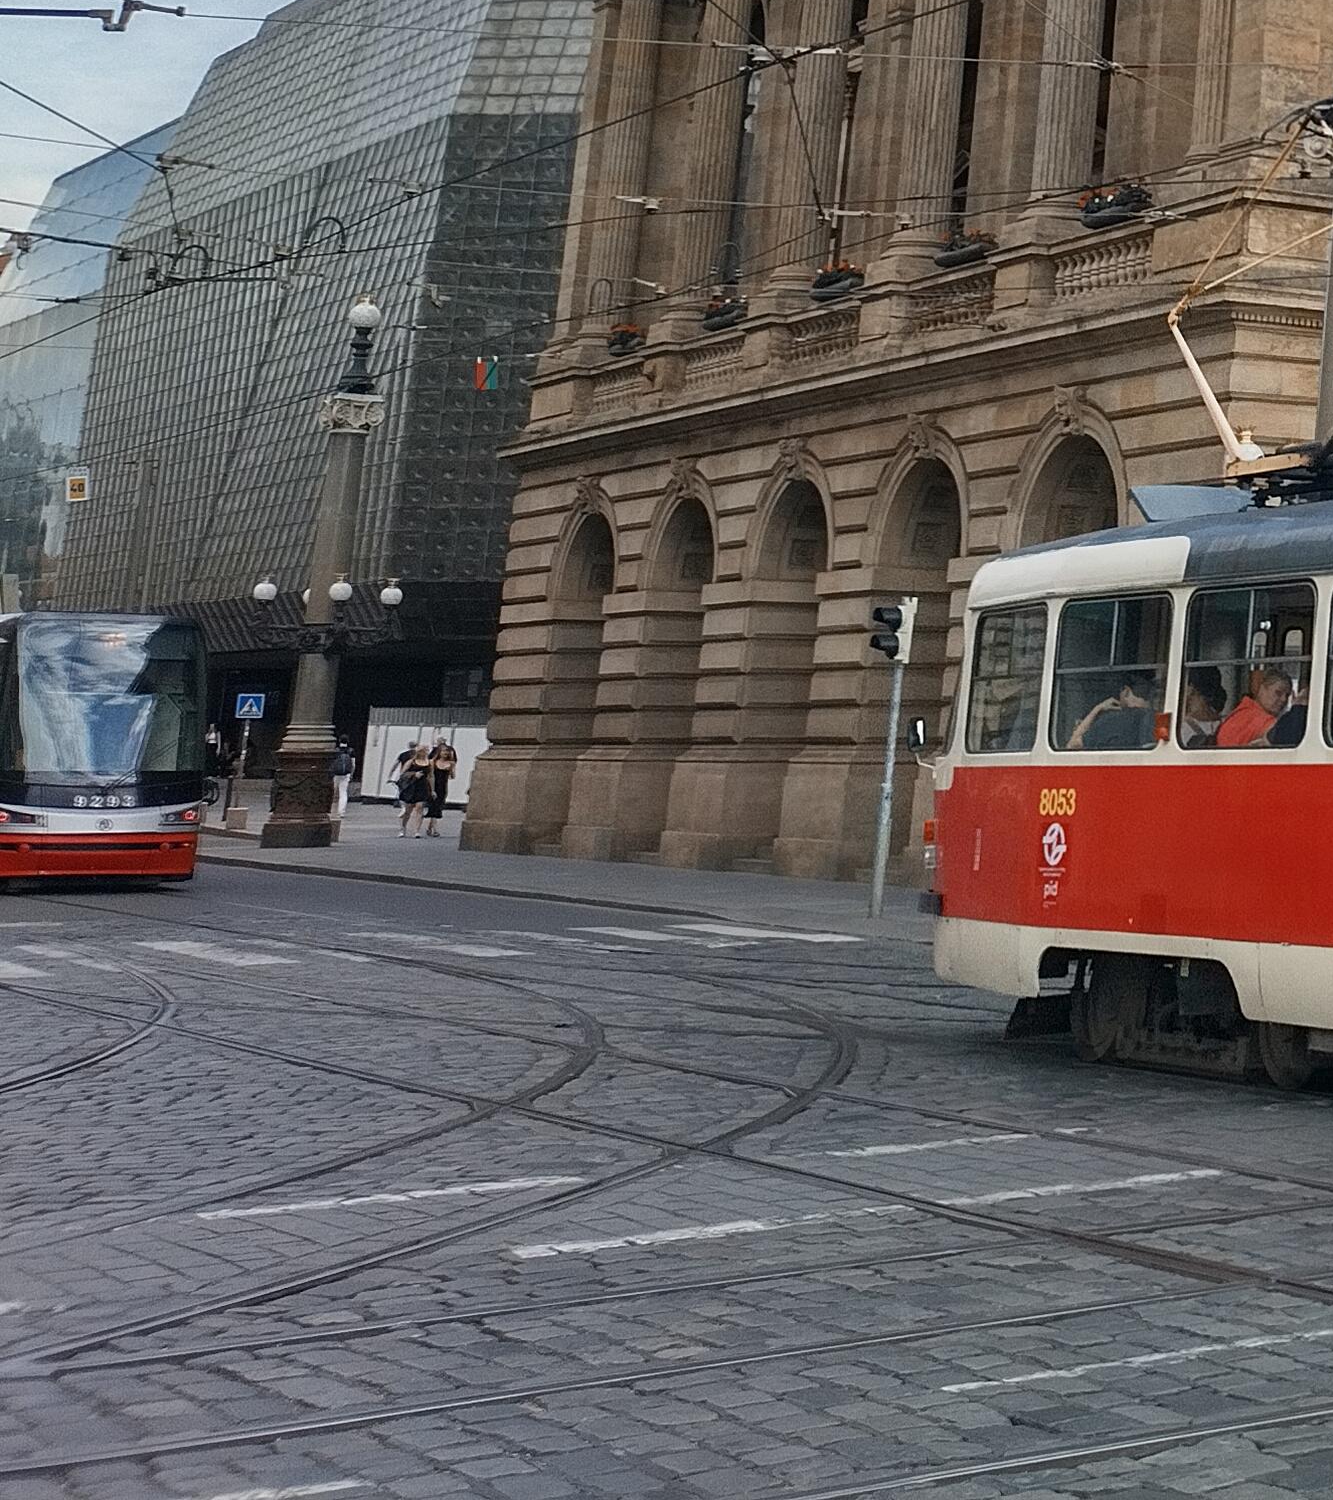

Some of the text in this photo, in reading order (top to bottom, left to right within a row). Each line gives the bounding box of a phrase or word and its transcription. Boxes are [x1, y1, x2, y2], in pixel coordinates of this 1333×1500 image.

[70, 483, 85, 493] 40
[73, 794, 136, 808] 9293
[1040, 788, 1076, 816] 8053
[1043, 880, 1059, 899] pid
